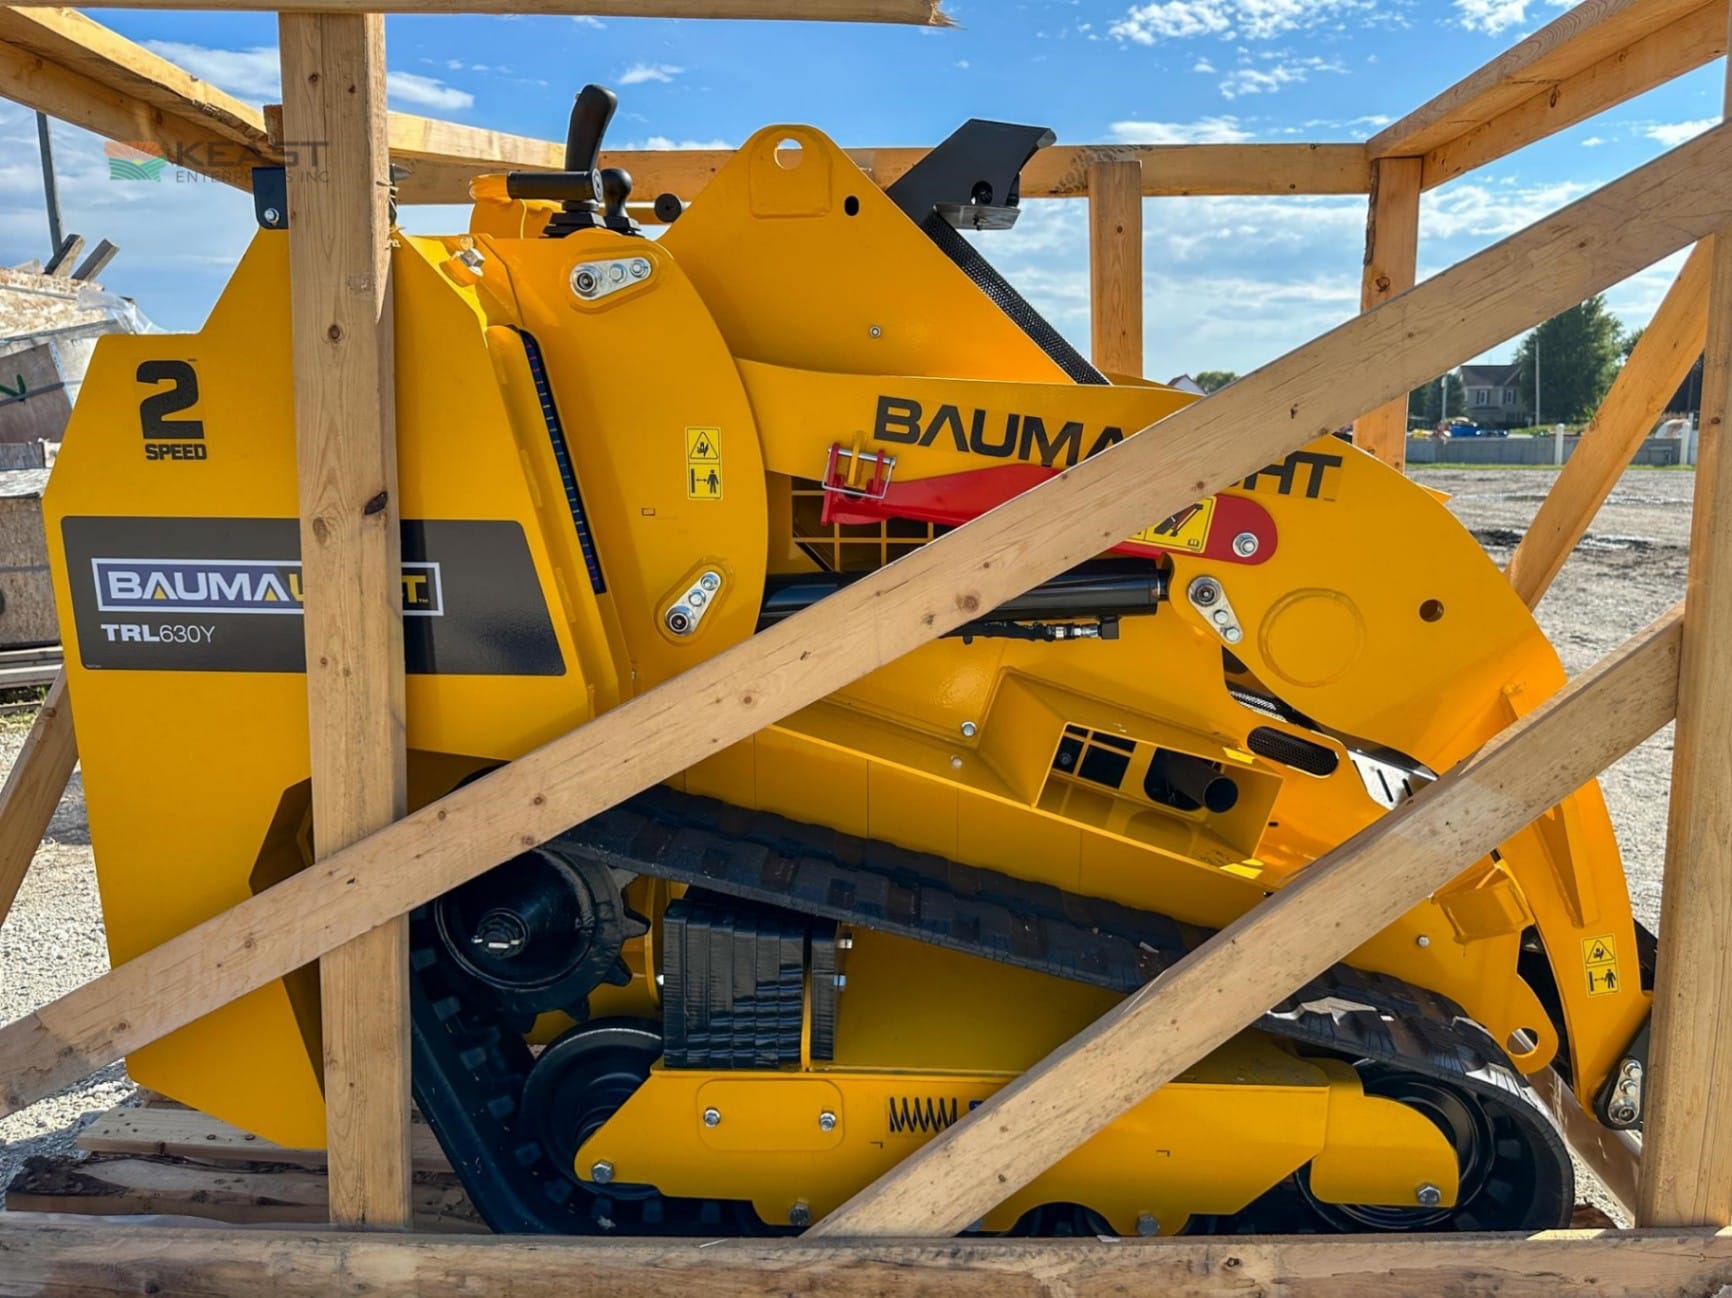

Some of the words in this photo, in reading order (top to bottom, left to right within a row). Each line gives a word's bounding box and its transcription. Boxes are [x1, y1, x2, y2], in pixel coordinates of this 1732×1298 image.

[136, 360, 204, 440] 2
[145, 443, 207, 460] SPEED
[873, 395, 1343, 499] BAUMAHT
[107, 571, 427, 604] BAUMALT
[100, 623, 216, 644] TRL630Y
